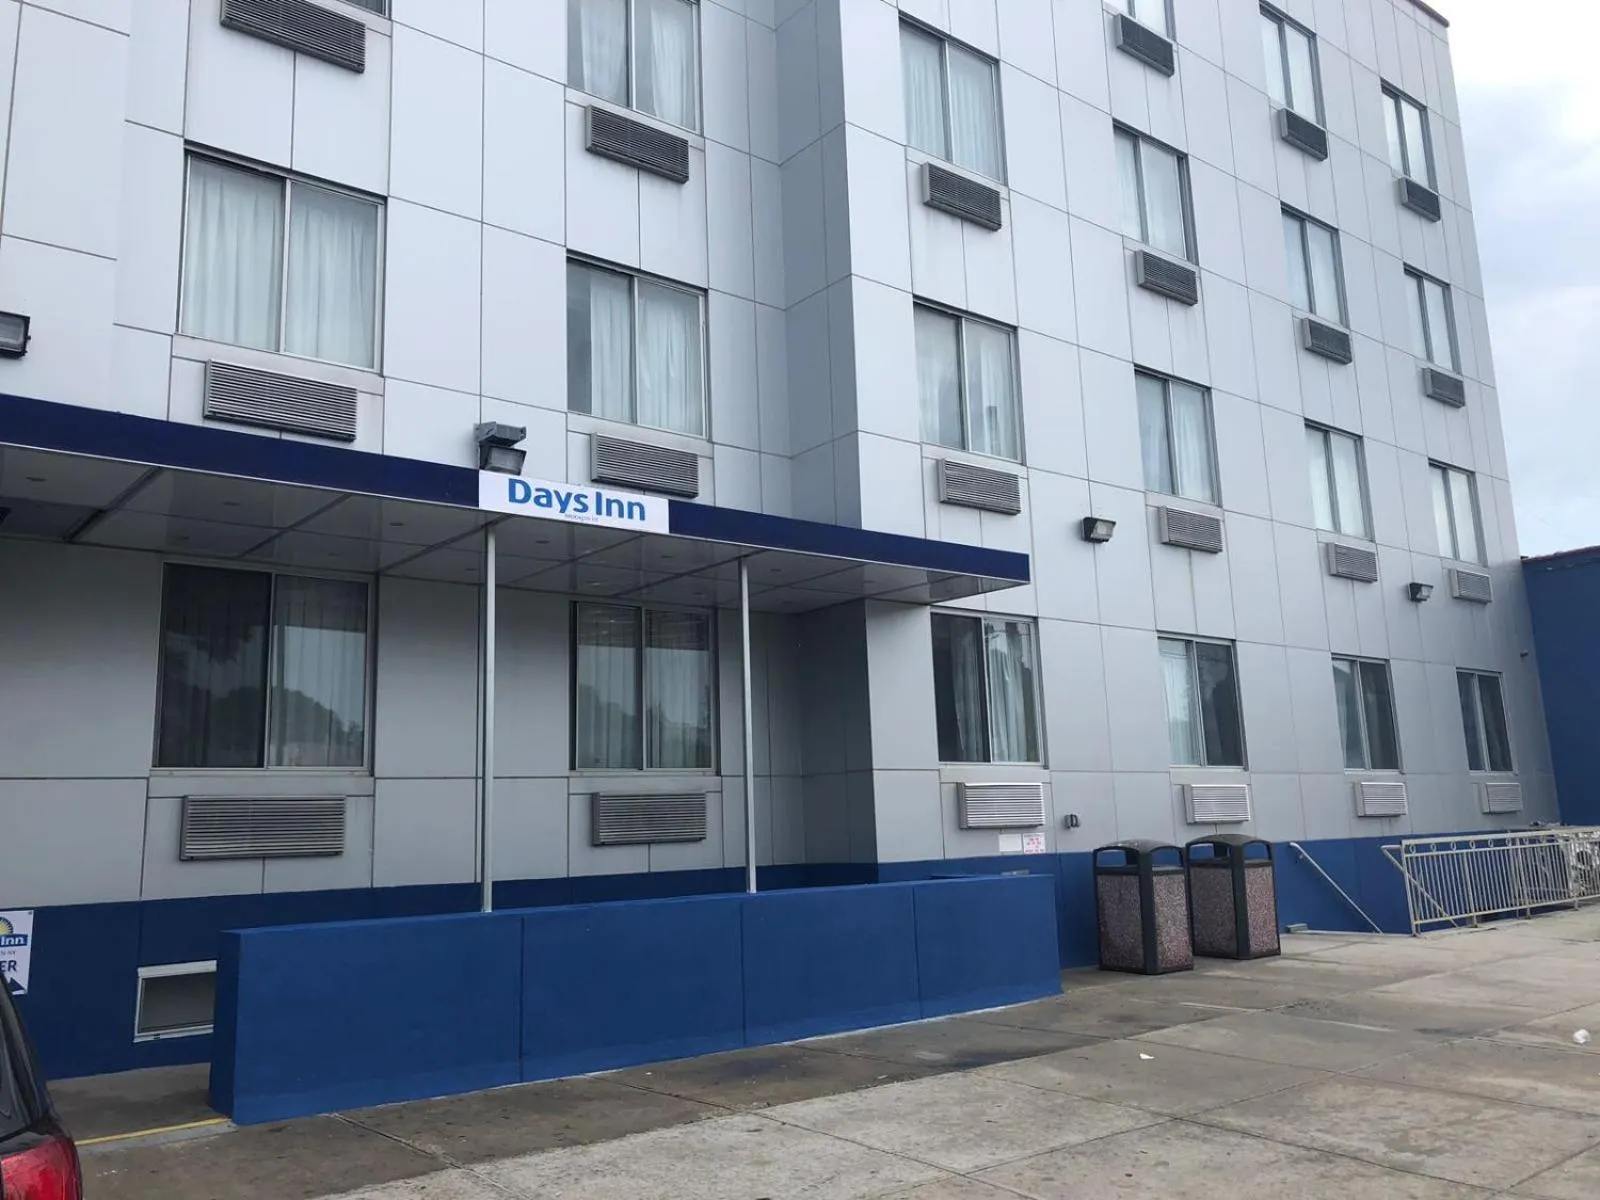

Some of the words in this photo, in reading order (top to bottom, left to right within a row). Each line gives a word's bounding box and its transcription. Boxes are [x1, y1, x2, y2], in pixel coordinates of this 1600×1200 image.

[508, 478, 589, 514] Days
[595, 491, 646, 522] Inn
[1, 935, 25, 946] Inn
